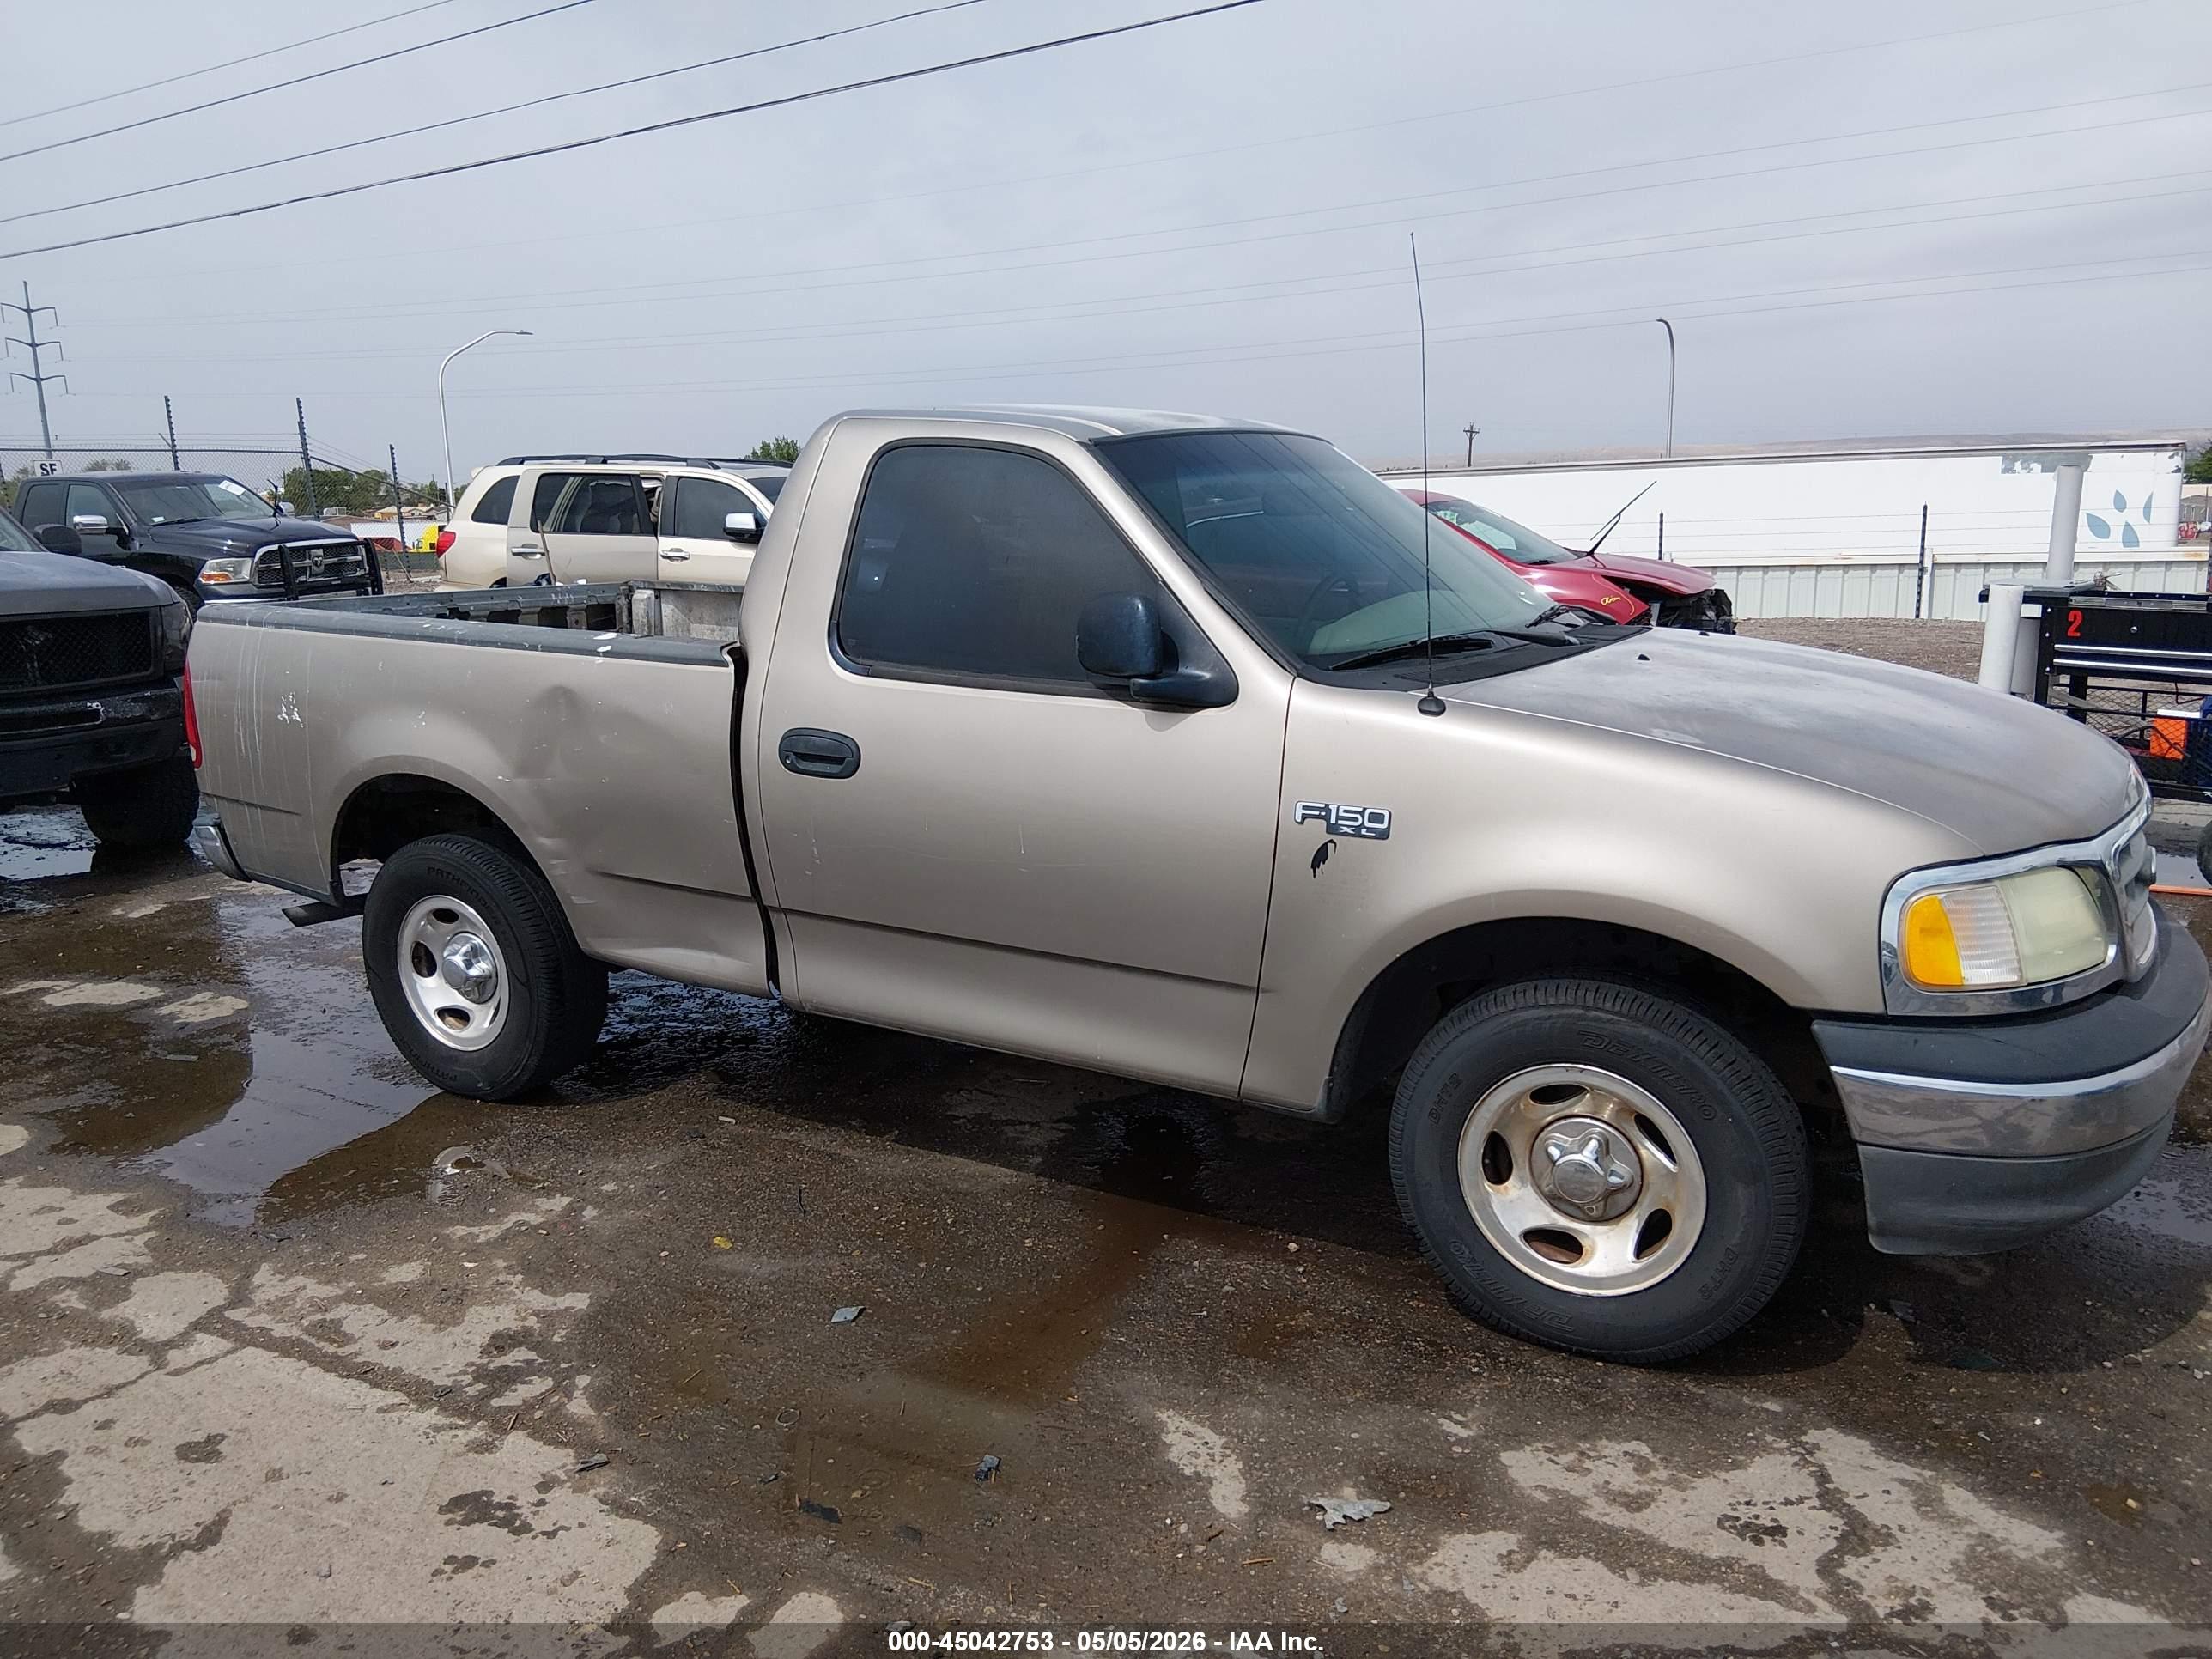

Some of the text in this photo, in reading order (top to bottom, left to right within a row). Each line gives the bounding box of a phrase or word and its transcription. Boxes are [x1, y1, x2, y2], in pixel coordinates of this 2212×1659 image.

[2067, 610, 2082, 637] 2
[1295, 801, 1389, 829] F-150
[1339, 826, 1376, 836] XL
